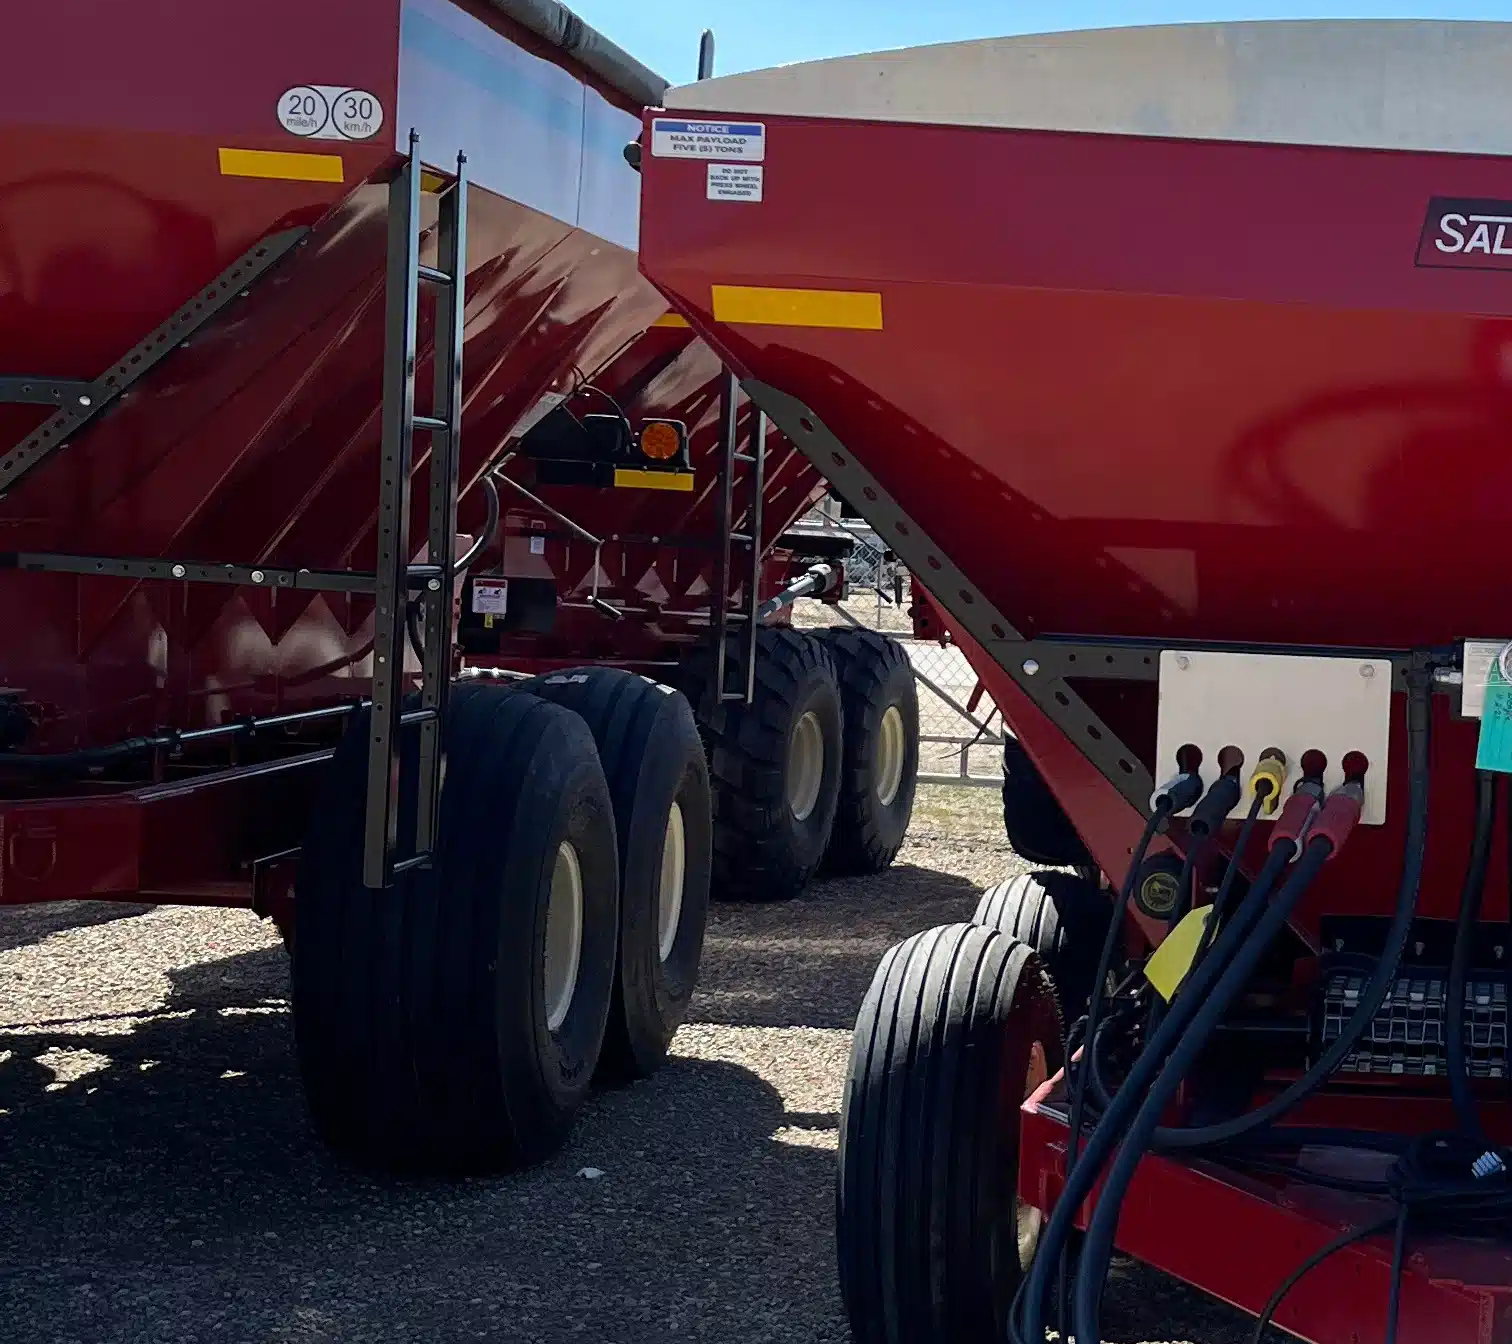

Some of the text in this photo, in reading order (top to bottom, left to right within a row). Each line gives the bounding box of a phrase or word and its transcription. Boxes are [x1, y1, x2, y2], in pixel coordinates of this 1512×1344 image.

[288, 95, 373, 119] 20 30
[286, 117, 372, 133] mile/h km/h
[686, 124, 729, 133] NOTICE
